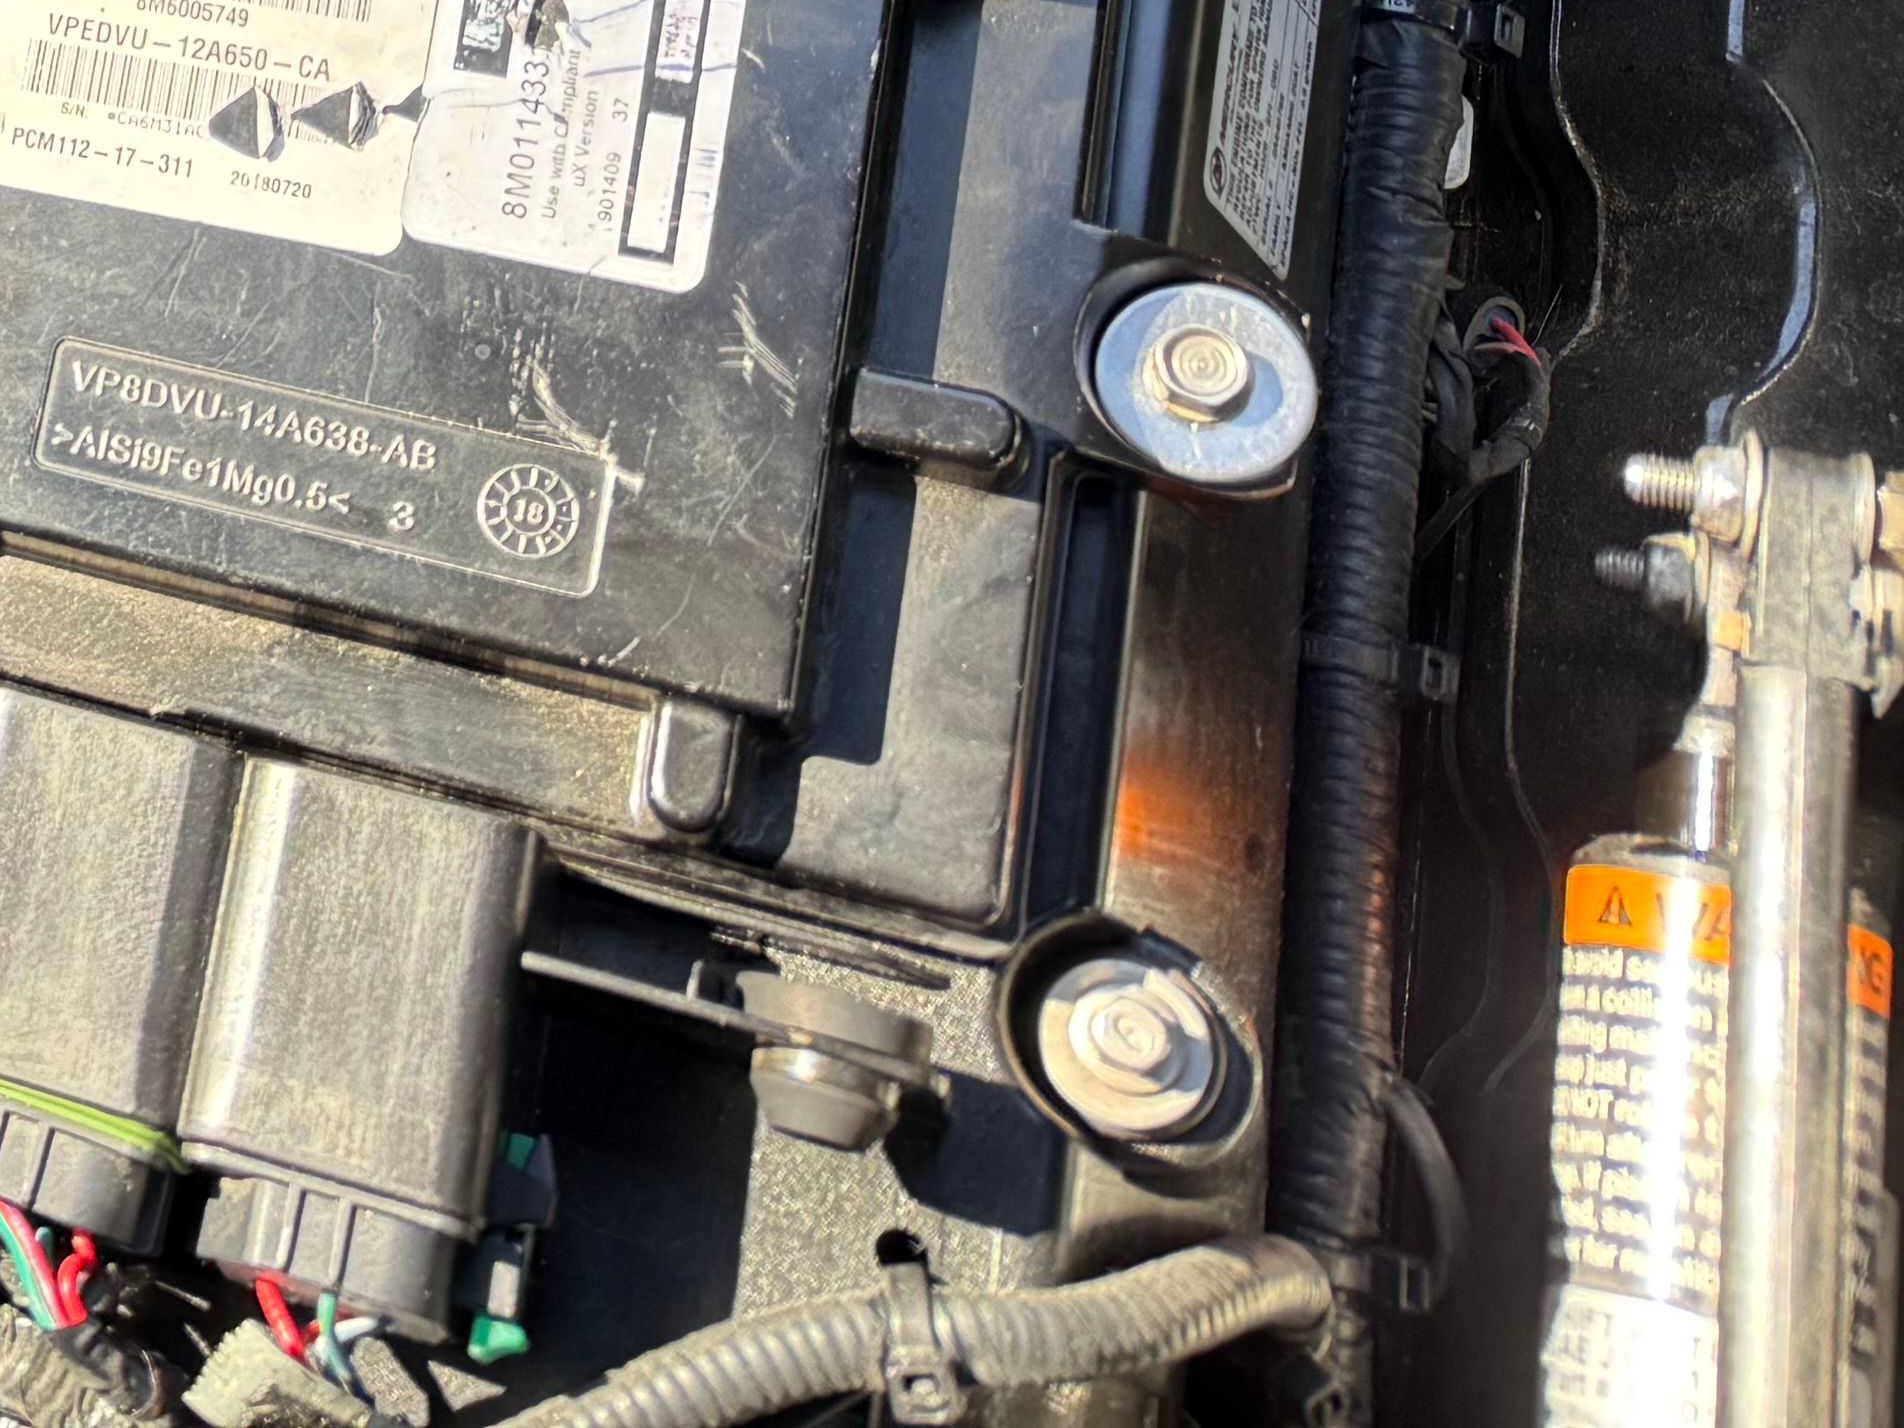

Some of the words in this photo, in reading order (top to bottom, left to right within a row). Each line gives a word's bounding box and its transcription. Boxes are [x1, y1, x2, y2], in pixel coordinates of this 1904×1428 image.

[619, 97, 630, 123] 37
[1231, 112, 1243, 171] ENGINE
[1238, 25, 1254, 111] CONFORMS
[576, 89, 600, 161] Version
[11, 125, 193, 178] PCM112-17-311
[229, 169, 313, 200] 20180720
[540, 193, 560, 220] Use
[70, 359, 439, 474] VP8DVU-14A638-AB
[389, 500, 416, 532] 3
[509, 496, 546, 524] 18
